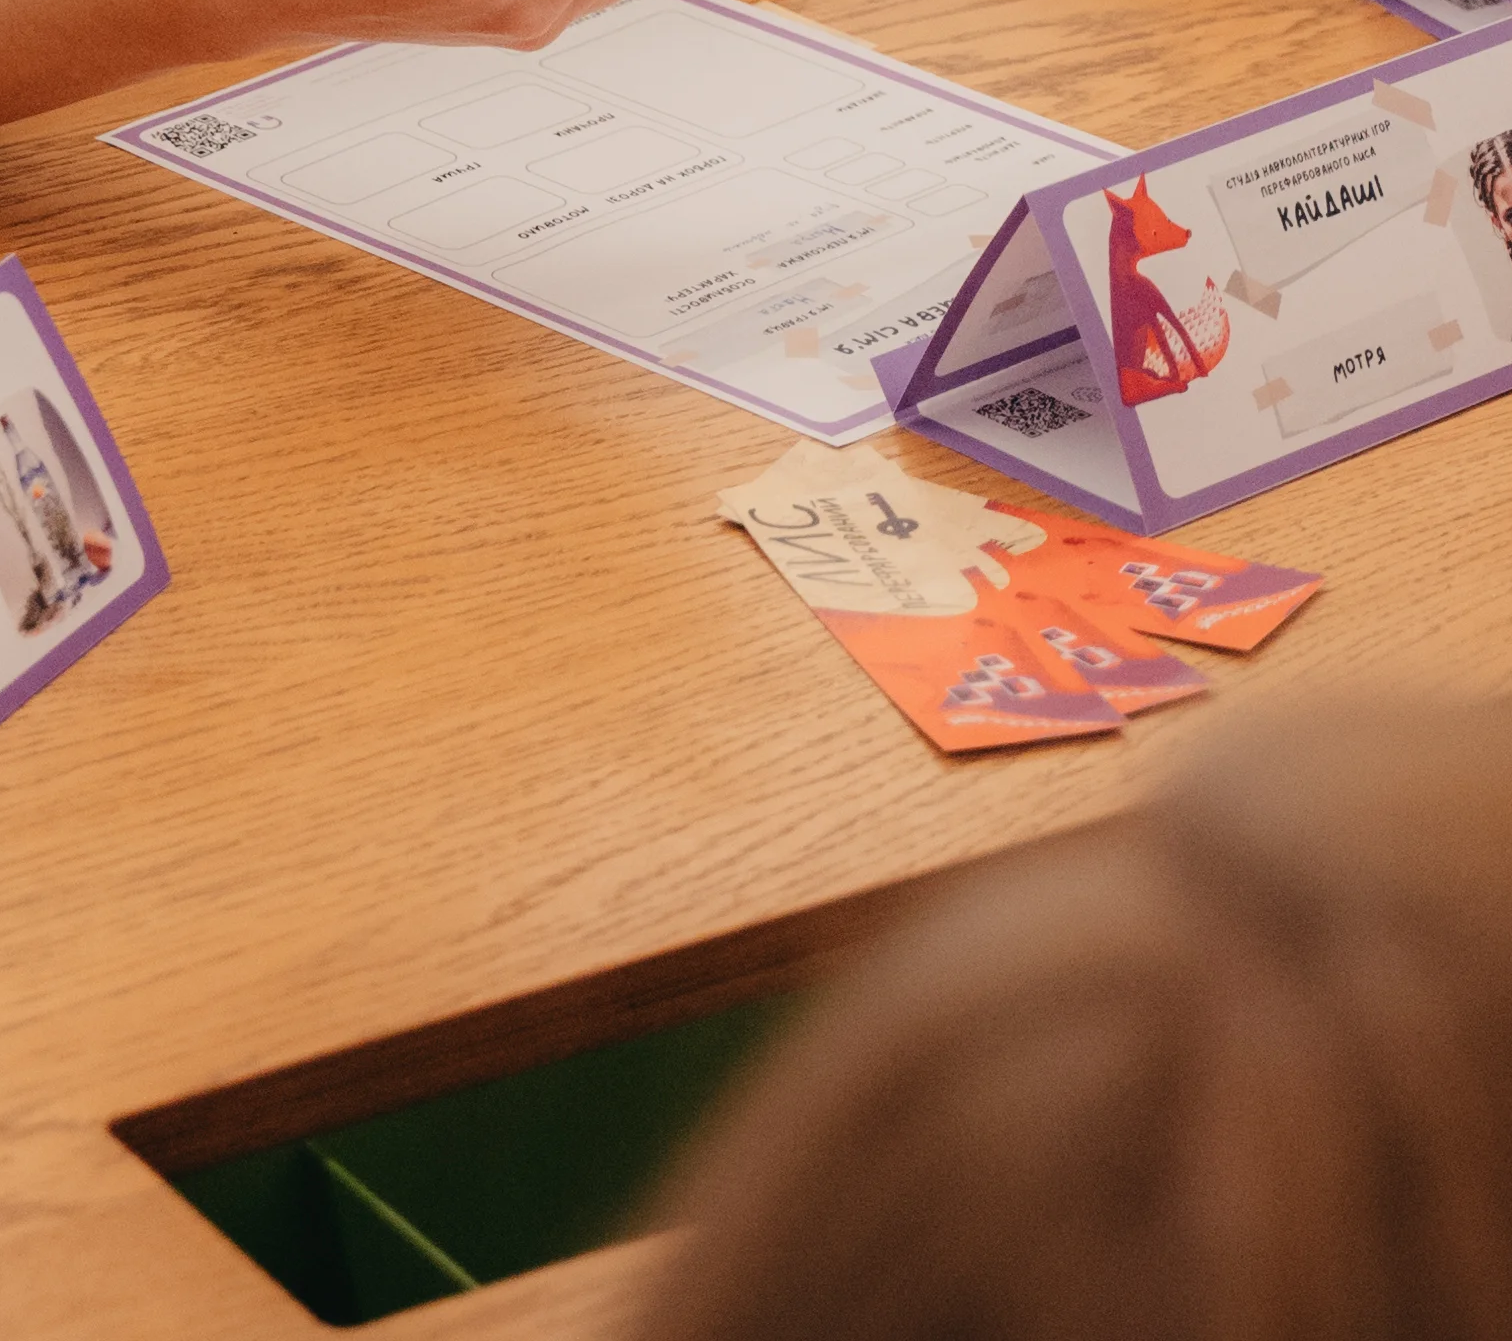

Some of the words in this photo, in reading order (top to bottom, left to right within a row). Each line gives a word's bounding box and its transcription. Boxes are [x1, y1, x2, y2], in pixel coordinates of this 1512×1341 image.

[553, 113, 615, 138] ПРОЧАНИ
[677, 155, 727, 179] ГОРБОК
[1226, 169, 1261, 189] СТУДІЯ
[1262, 128, 1371, 179] НАВКОЛОЛІТЕРАТУРНИХ
[1371, 119, 1392, 137] ІГОР
[432, 161, 482, 183] ГРУША
[656, 174, 677, 187] НА
[1260, 156, 1351, 198] ПЕРЕФАРБОВАНОГО
[1353, 146, 1377, 165] ЛИСА
[605, 182, 654, 205] ДОРОЗІ
[1277, 174, 1385, 231] КАЙДАШІ
[517, 206, 590, 240] МОТОВИЛО
[664, 270, 739, 303] ХАРАКТЕРУ
[668, 277, 756, 317] ОСОБЛИВОСТІ
[833, 325, 900, 355] СІМ'Я
[1333, 346, 1386, 383] МОТРЯ
[747, 503, 874, 588] ЛИС
